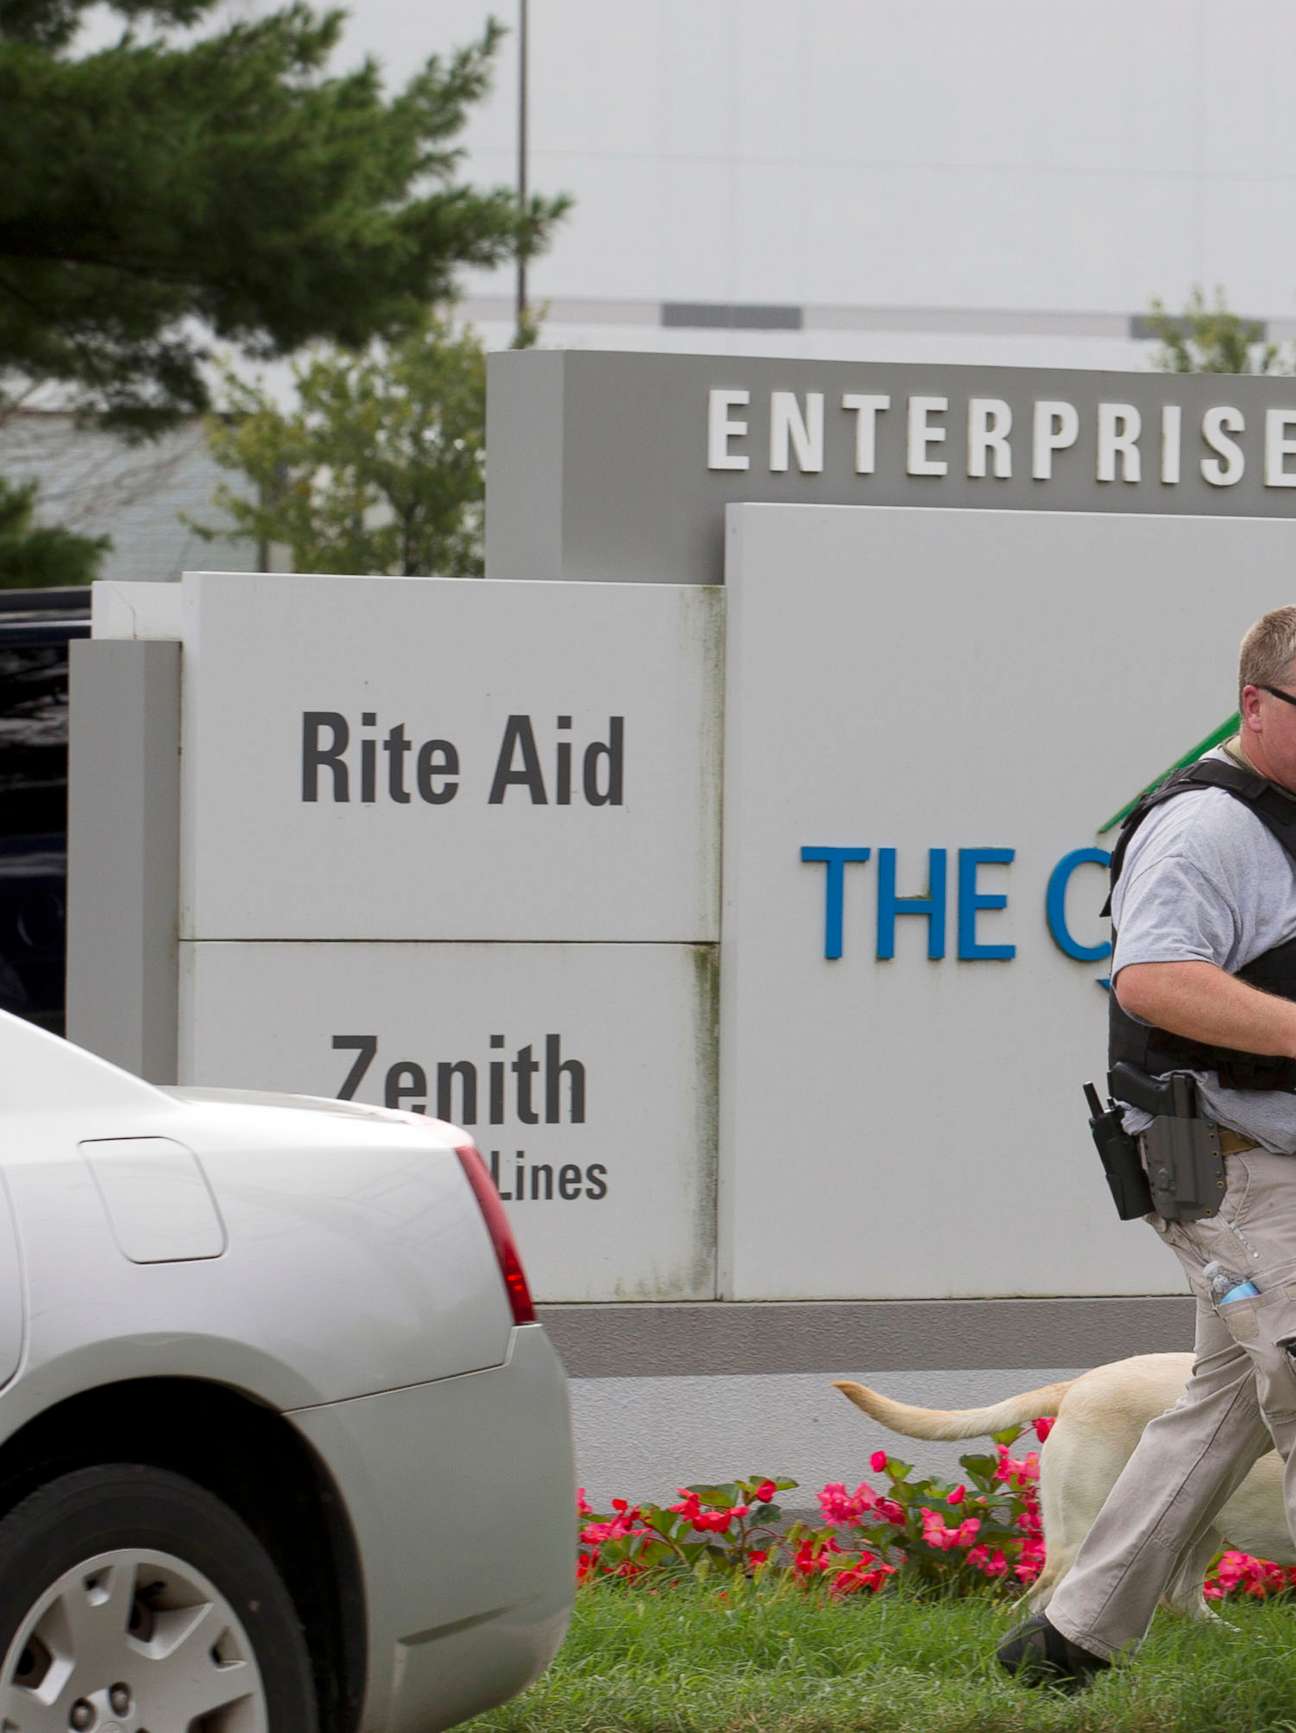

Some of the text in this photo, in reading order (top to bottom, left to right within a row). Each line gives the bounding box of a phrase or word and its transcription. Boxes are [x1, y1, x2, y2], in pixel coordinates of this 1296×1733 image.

[302, 711, 625, 806] Rite Aid
[800, 846, 1017, 961] THE
[331, 1033, 586, 1126] Zenith
